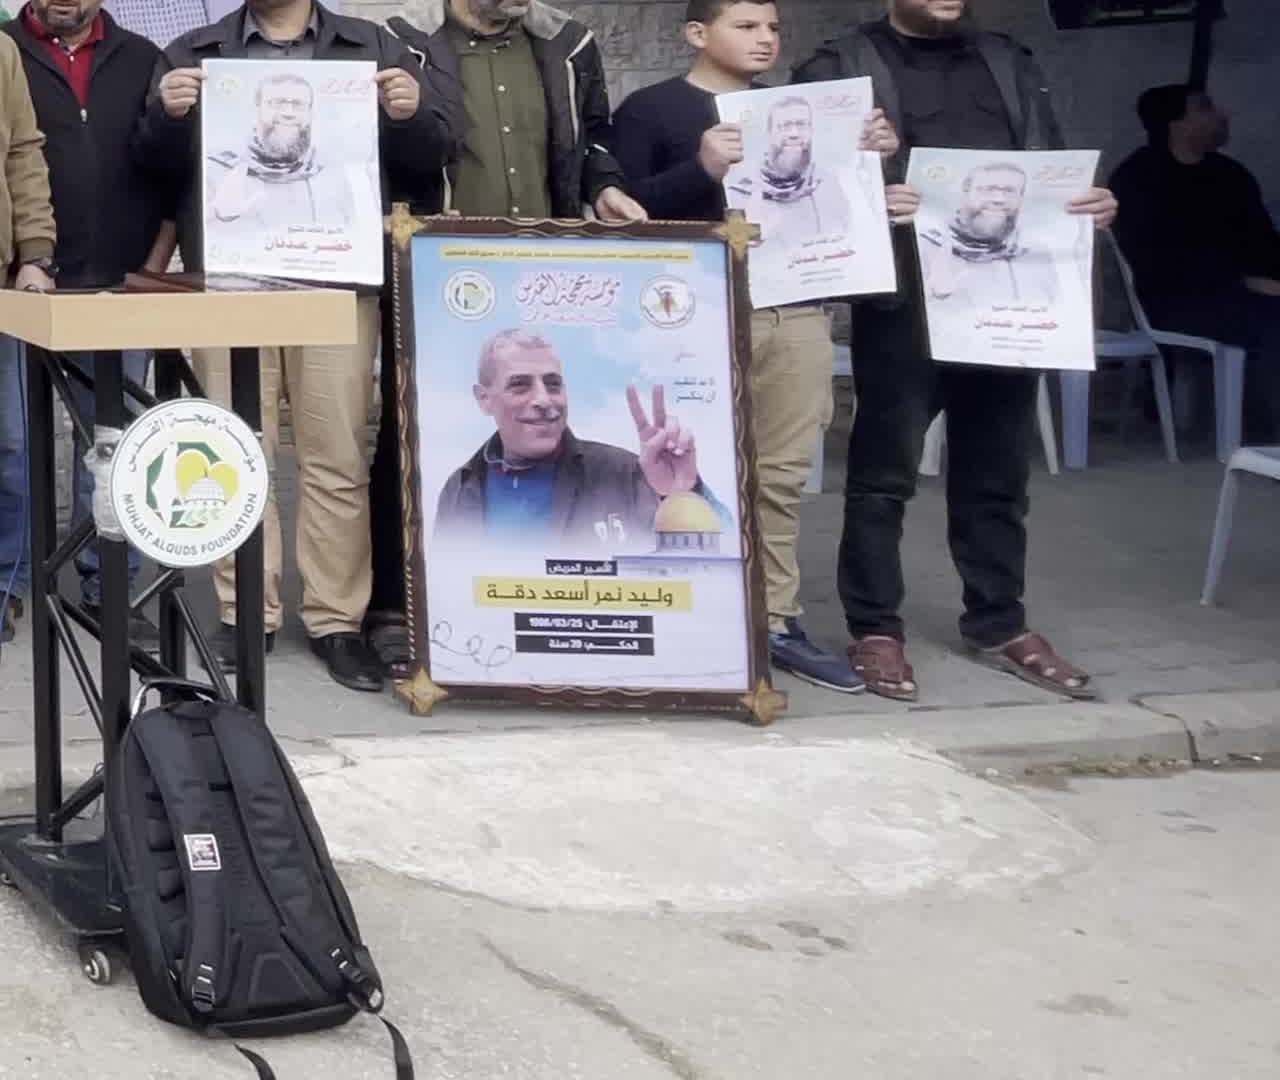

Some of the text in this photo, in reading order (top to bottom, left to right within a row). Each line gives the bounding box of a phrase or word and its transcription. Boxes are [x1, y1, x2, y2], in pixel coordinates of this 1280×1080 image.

[123, 492, 258, 556] MUHJAT ALQUDS FOUNDATION
[486, 579, 673, 607] وليد نمر أسعد دقة
